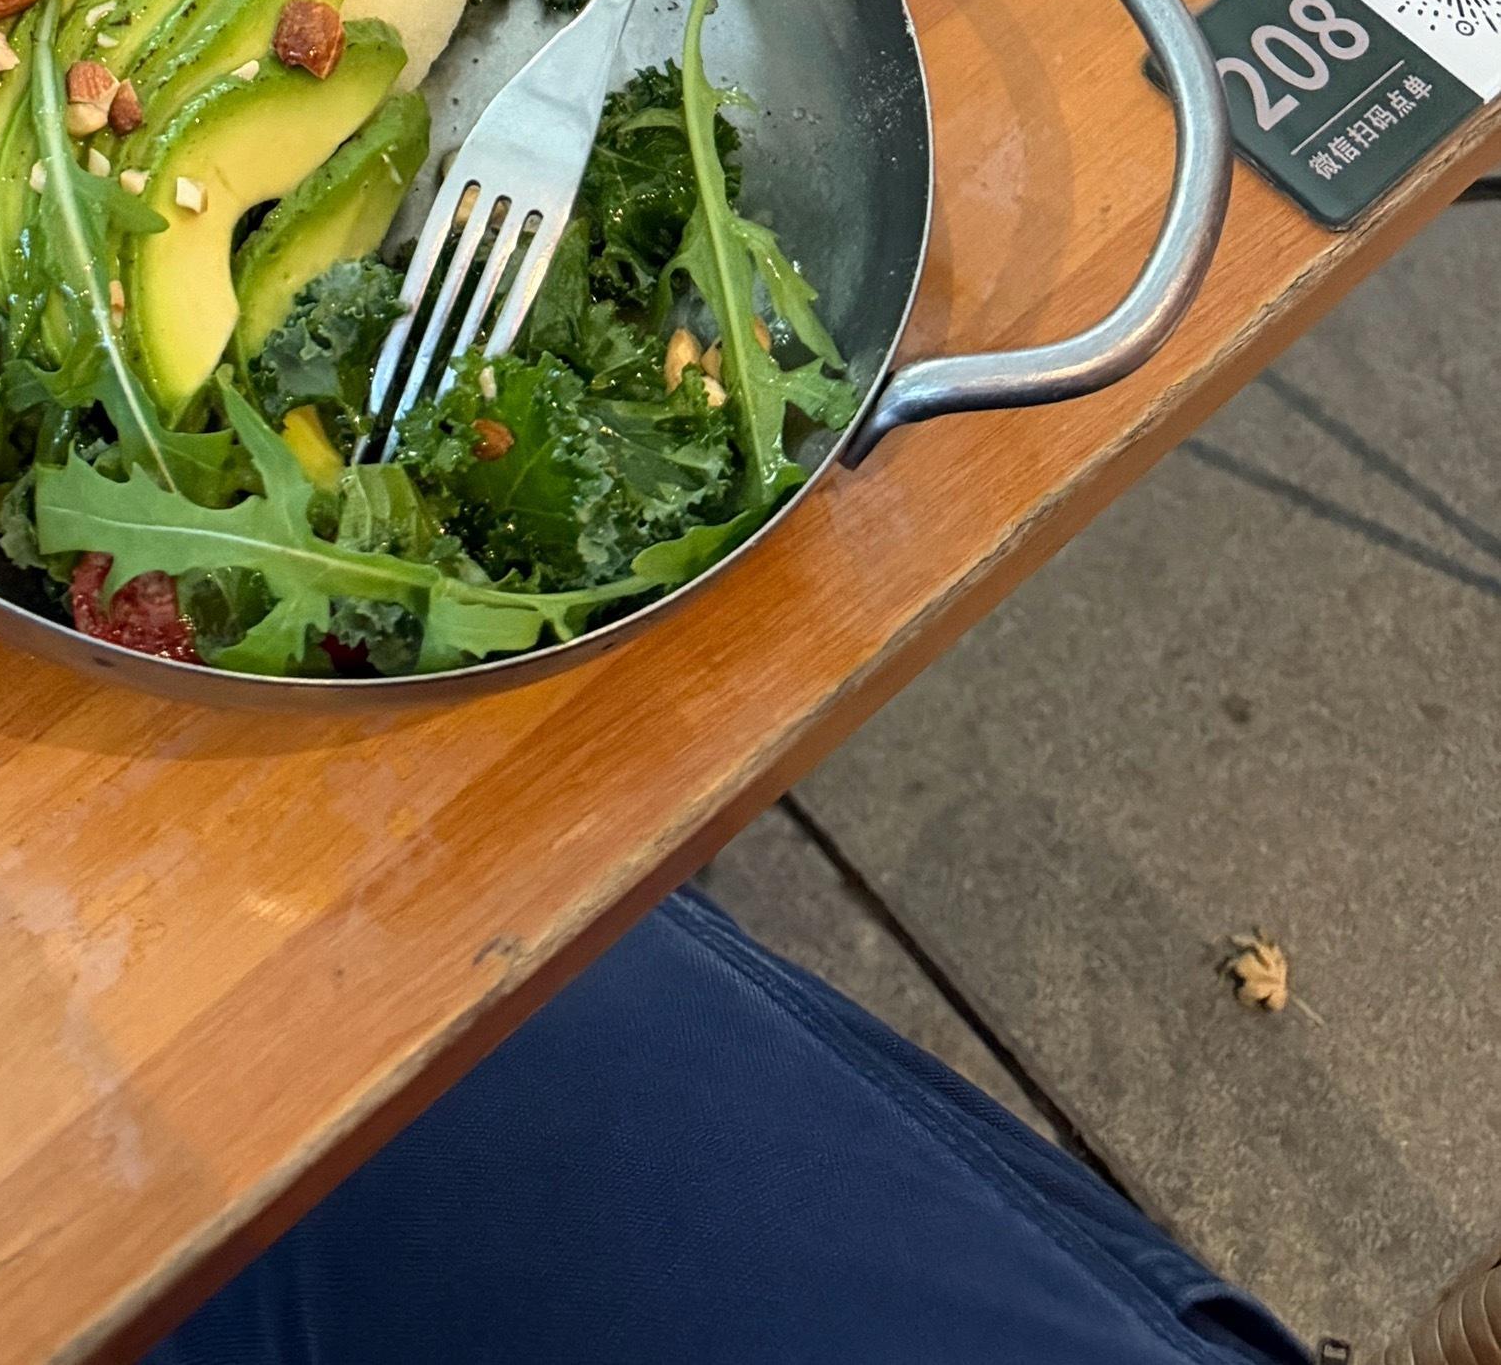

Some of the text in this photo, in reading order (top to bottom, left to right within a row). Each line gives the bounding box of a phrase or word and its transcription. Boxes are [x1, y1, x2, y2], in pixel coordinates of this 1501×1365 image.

[1308, 74, 1433, 181] 微信扫码点单
